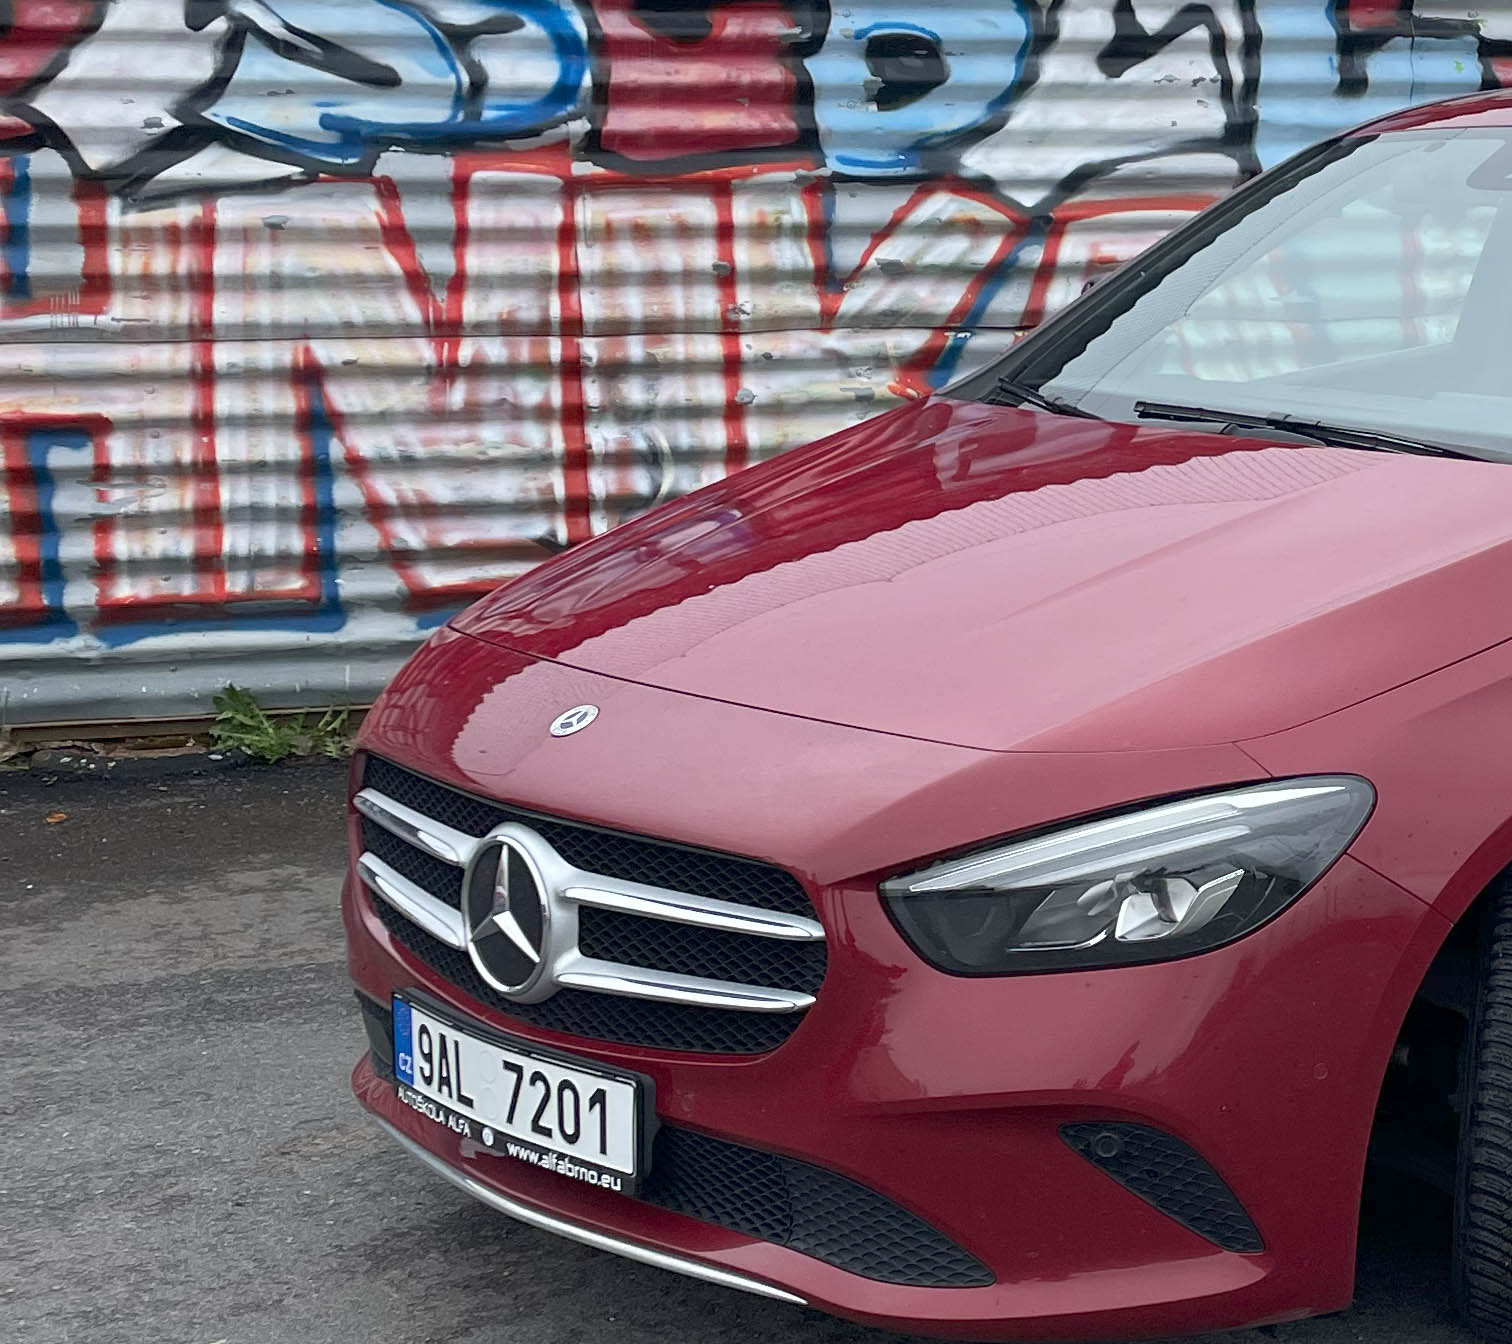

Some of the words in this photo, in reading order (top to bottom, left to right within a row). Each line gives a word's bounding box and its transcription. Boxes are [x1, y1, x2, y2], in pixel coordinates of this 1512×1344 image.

[398, 1052, 413, 1074] CZ
[417, 1023, 474, 1109] 9AL
[502, 1059, 608, 1156] 7201
[506, 1141, 622, 1192] www.alfabrno.eu
